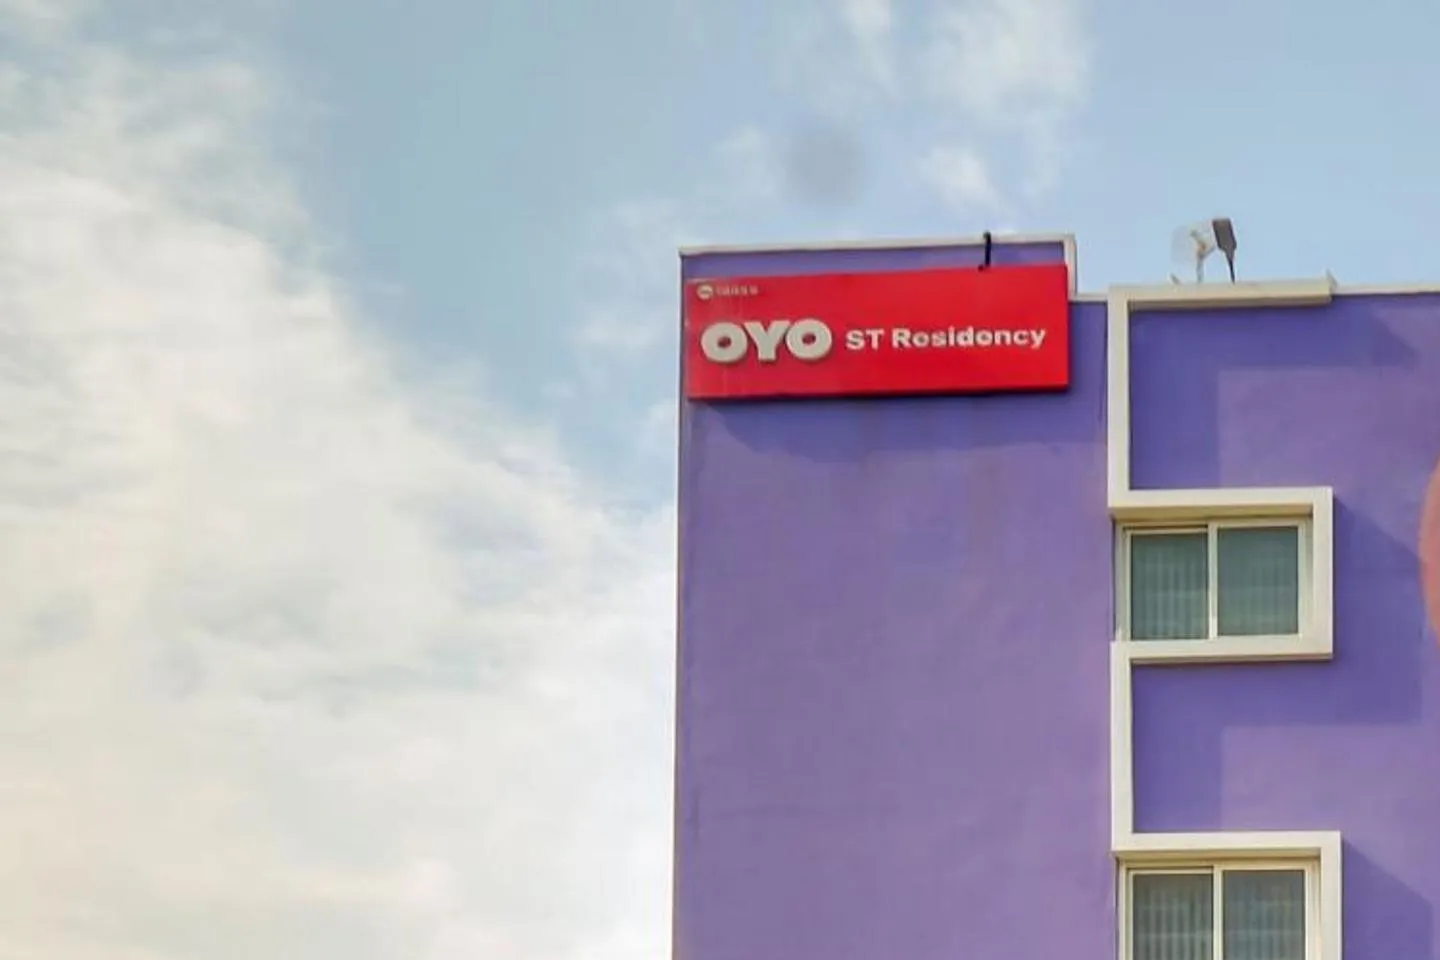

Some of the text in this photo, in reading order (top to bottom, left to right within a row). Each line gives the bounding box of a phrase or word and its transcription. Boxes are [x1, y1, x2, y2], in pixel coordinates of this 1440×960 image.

[701, 317, 1046, 364] OYO ST Residency
